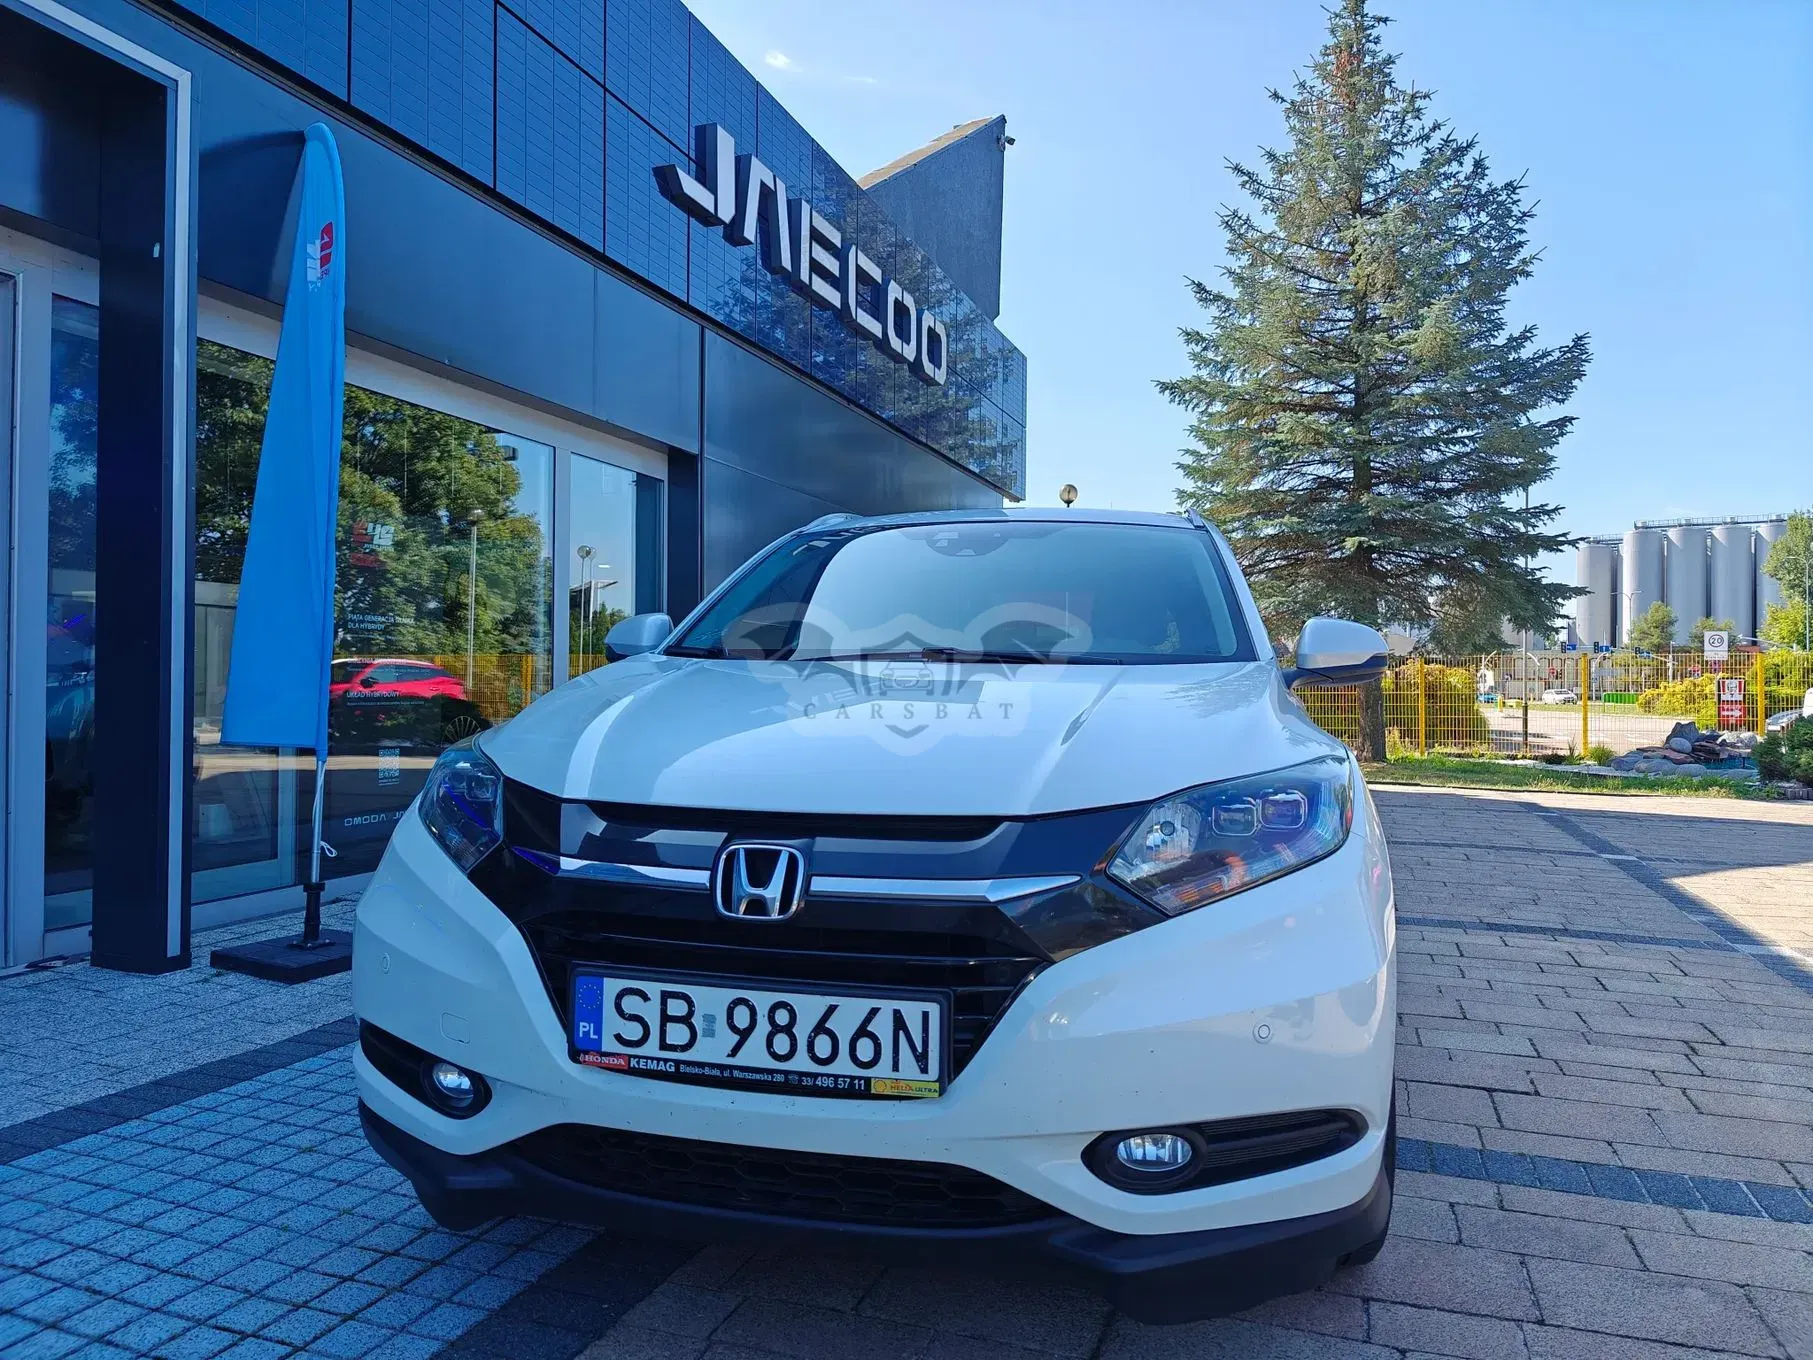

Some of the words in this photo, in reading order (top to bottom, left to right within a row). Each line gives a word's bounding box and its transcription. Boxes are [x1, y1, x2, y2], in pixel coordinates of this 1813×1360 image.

[652, 122, 947, 386] JAECOO
[344, 813, 387, 827] OMODA
[579, 1021, 598, 1039] PL
[613, 986, 698, 1053] SB
[725, 996, 930, 1075] 9866N
[584, 1054, 626, 1066] HONDA
[630, 1057, 675, 1072] KEMAG
[815, 1076, 834, 1088] 496
[837, 1077, 850, 1089] 57
[853, 1079, 865, 1090] 11
